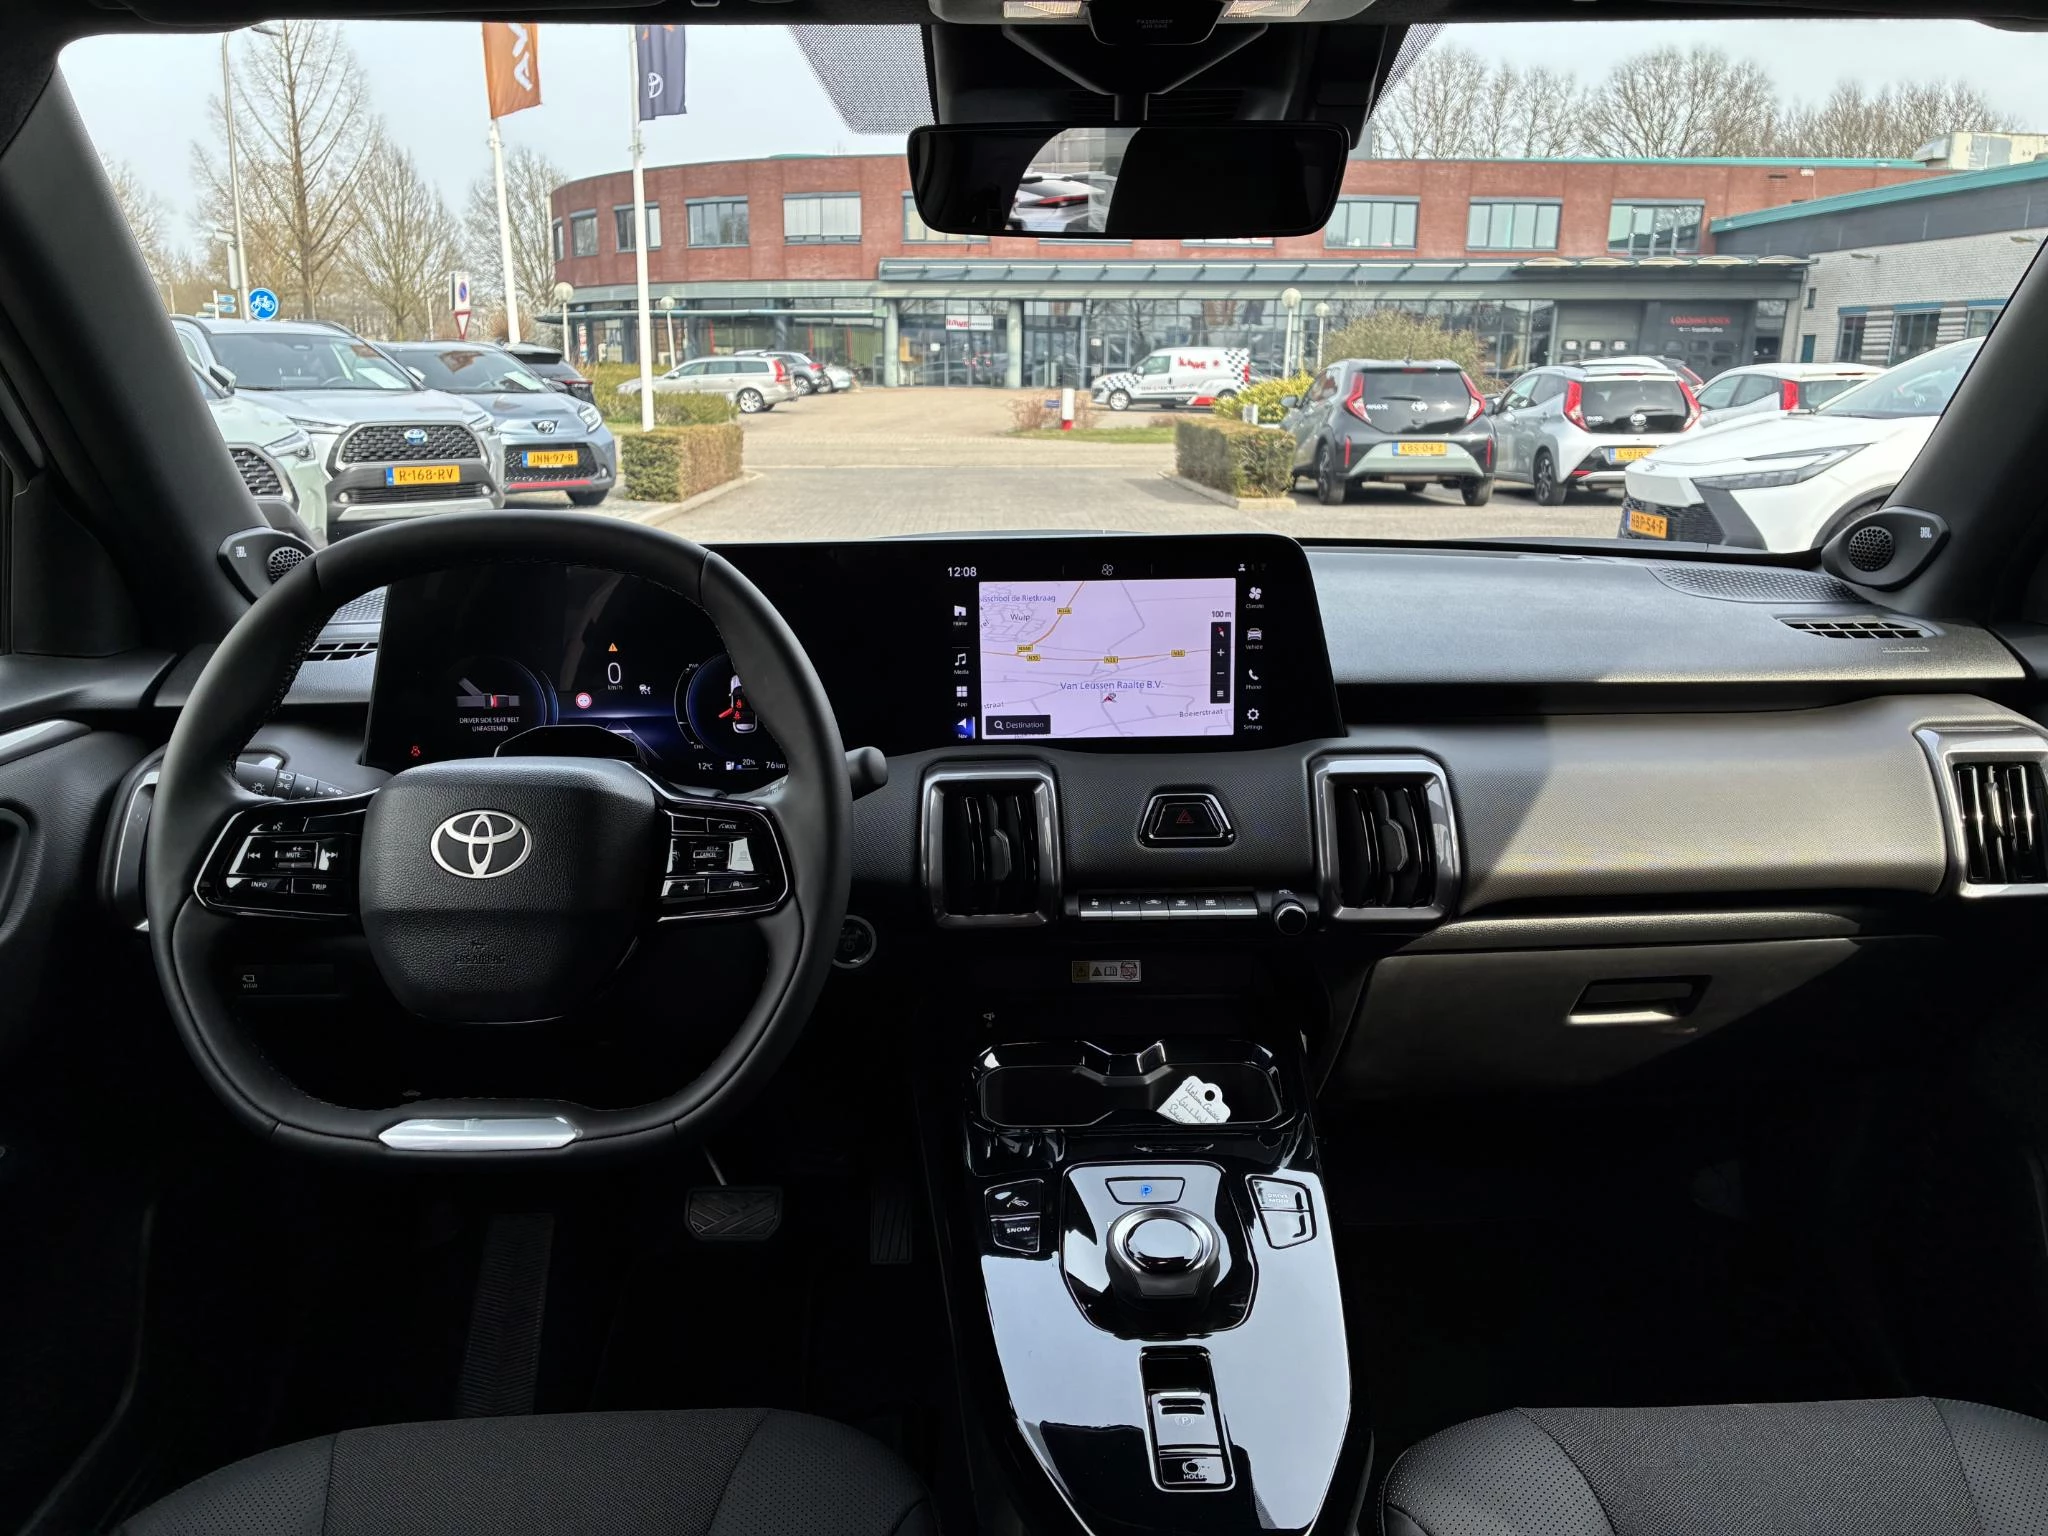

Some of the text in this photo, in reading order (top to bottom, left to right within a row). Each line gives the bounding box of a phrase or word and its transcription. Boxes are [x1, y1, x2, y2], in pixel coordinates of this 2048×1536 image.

[399, 468, 453, 481] R-168-RV
[948, 567, 977, 577] 12:08
[1211, 610, 1224, 618] 100
[1060, 681, 1078, 690] Van
[1080, 681, 1115, 690] Leussen
[1146, 680, 1164, 689] B.V.
[1005, 720, 1044, 729] Destination
[742, 758, 756, 766] 20%
[1141, 1185, 1152, 1196] P
[1006, 1226, 1031, 1234] SNOW
